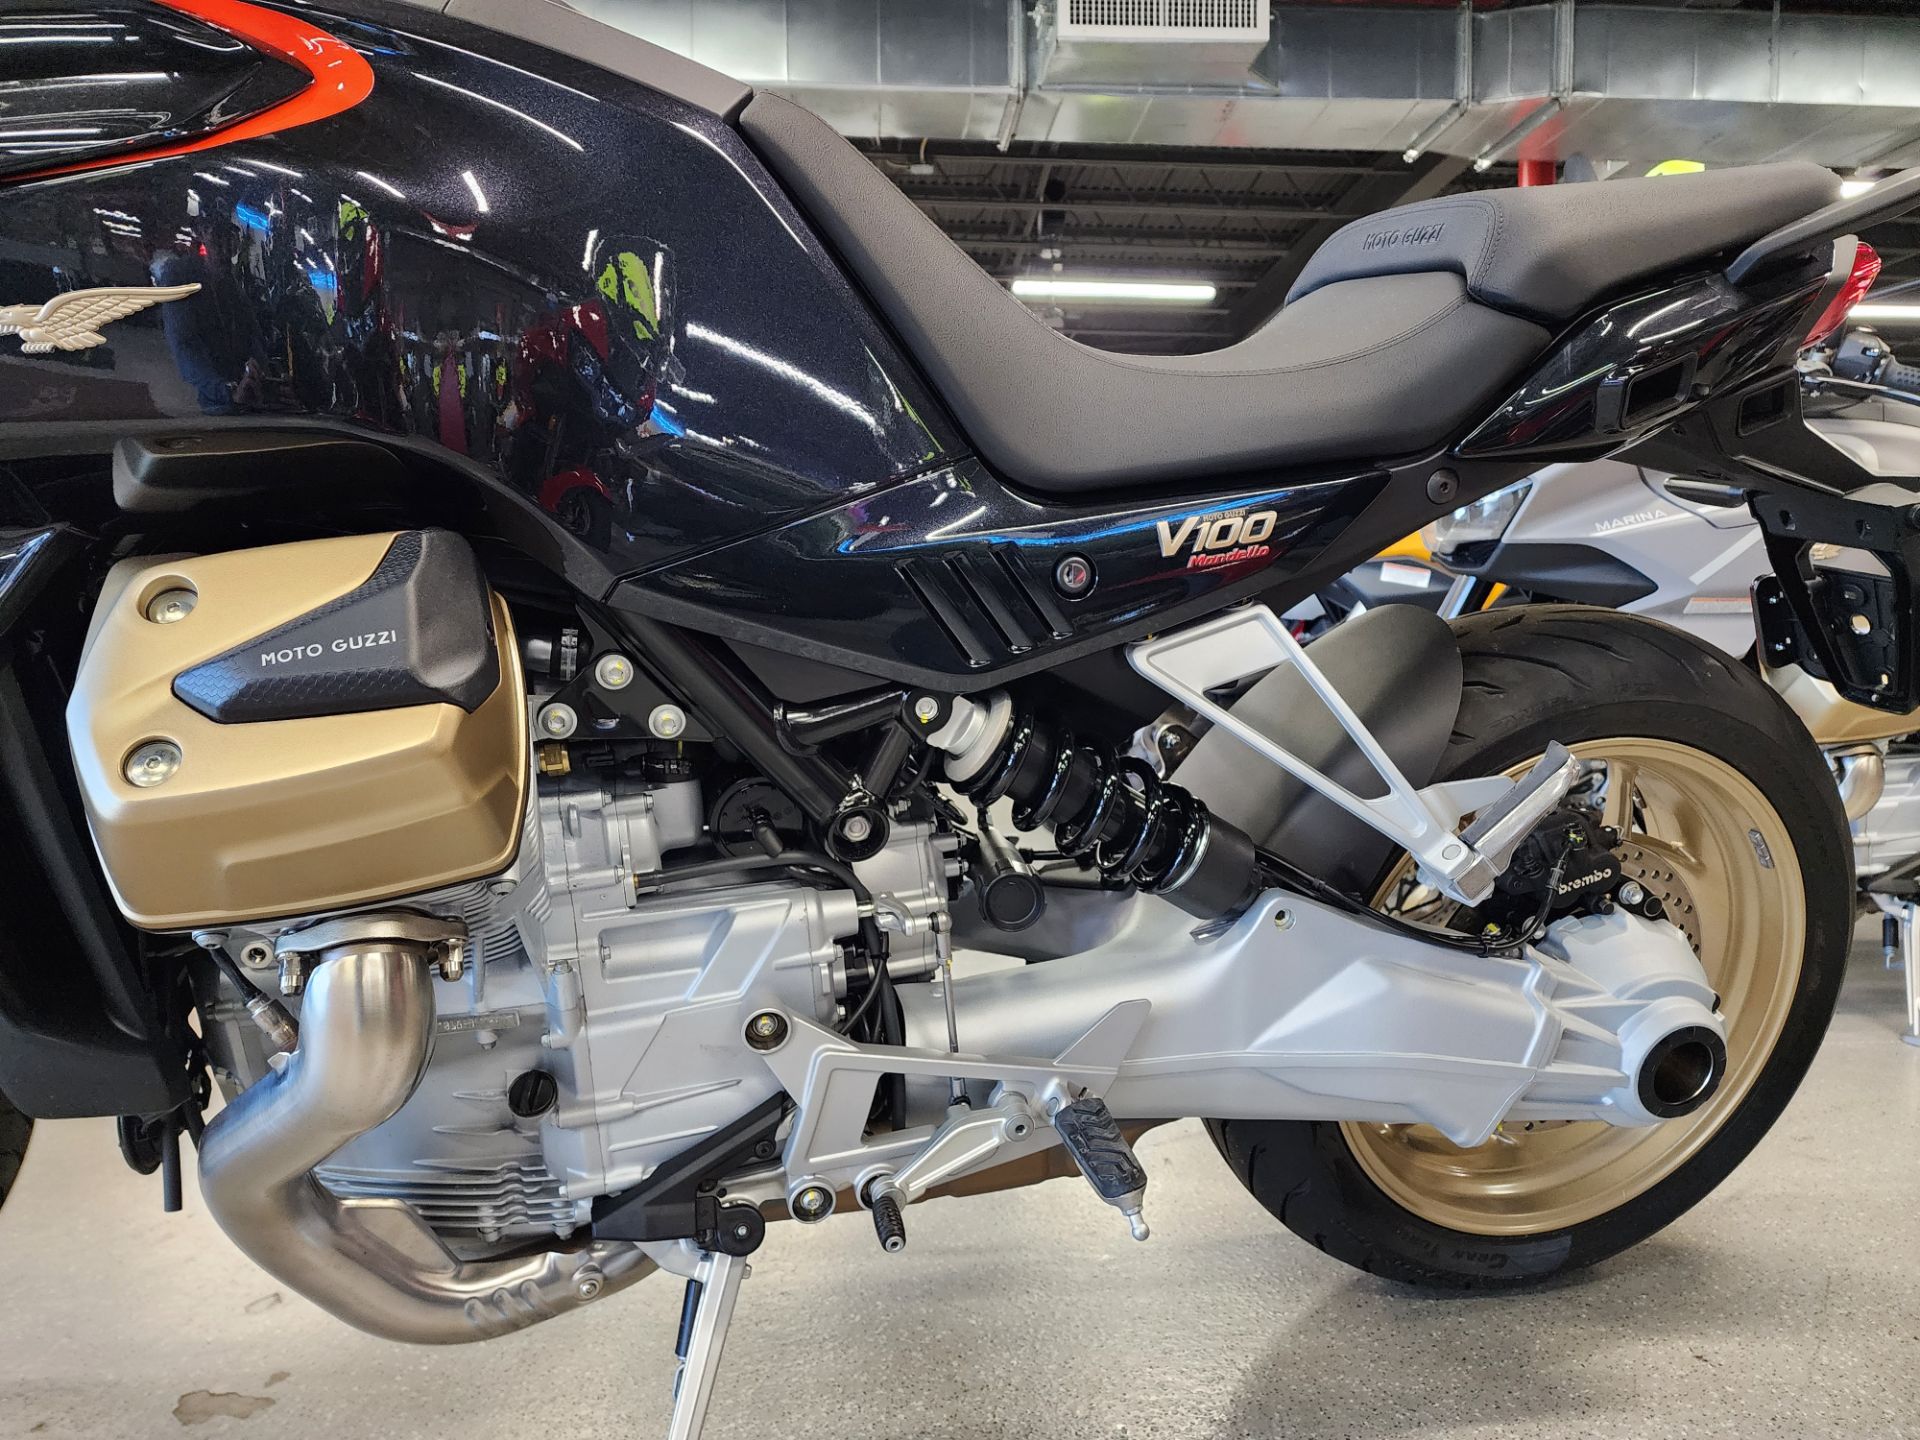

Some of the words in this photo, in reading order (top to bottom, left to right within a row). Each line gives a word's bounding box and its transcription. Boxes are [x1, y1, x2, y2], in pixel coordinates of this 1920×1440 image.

[1362, 230, 1400, 250] MOTO
[1402, 222, 1445, 245] GUZZI
[1156, 510, 1278, 558] V100
[1594, 509, 1667, 532] MARINA
[1186, 544, 1270, 569] Mandello
[261, 643, 323, 667] MOTO
[331, 629, 397, 653] GUZZI
[1558, 867, 1612, 895] brembo
